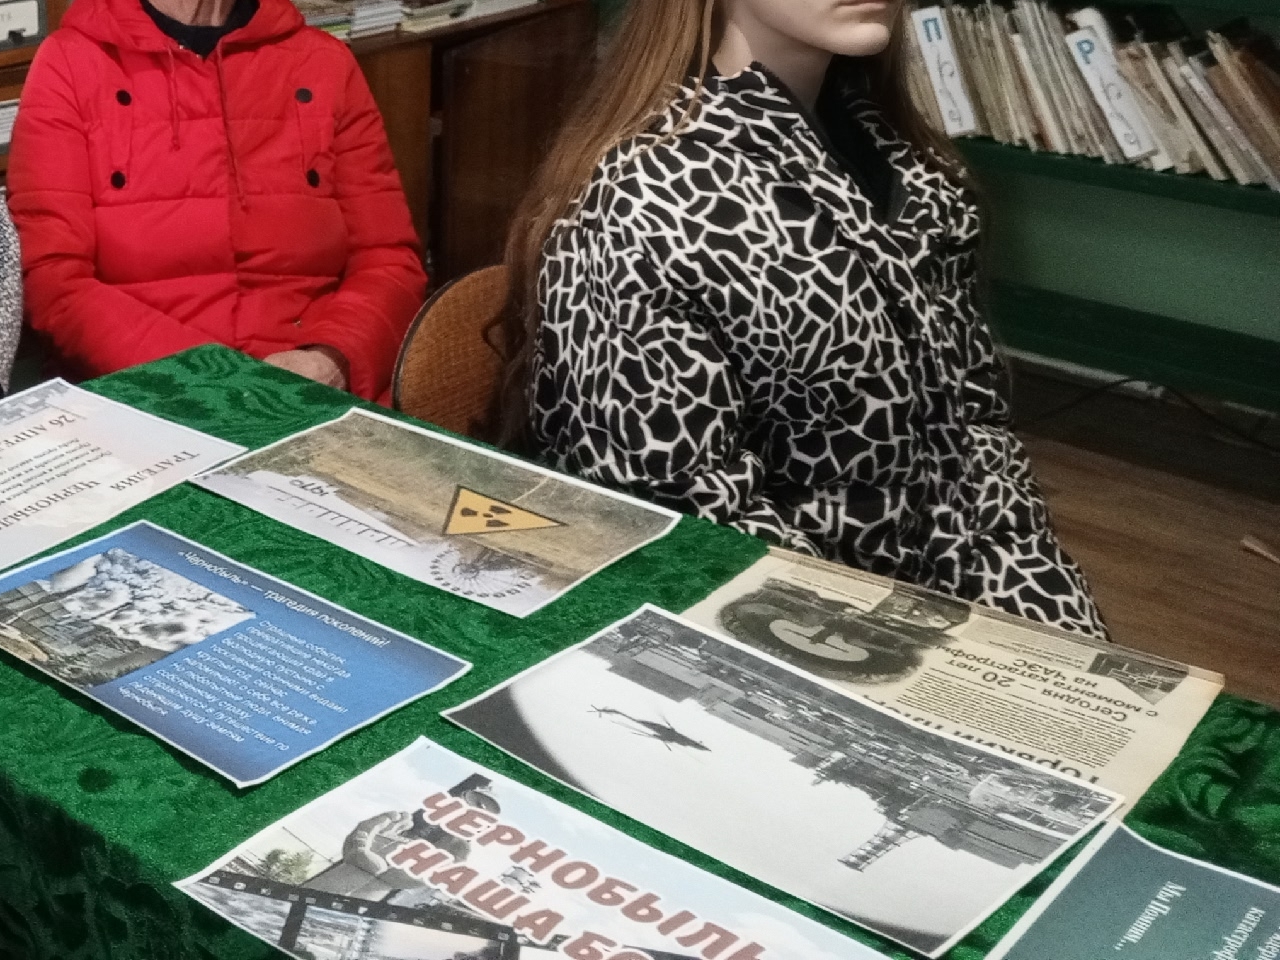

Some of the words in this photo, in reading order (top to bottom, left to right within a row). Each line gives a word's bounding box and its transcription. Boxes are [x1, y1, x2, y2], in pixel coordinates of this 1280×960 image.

[922, 17, 943, 43] П
[1076, 39, 1095, 65] Р
[47, 414, 76, 427] 26
[173, 550, 253, 585] «Чернобыль»
[261, 589, 321, 616] трагедия
[315, 612, 391, 647] поколений!
[934, 644, 1052, 684] катастрофы
[945, 658, 982, 673] лет
[1012, 658, 1070, 681] ЧАЭС
[982, 671, 1016, 689] 20
[1073, 677, 1099, 689] на
[1041, 688, 1128, 722] Сегодня
[1056, 683, 1142, 713] момента
[389, 842, 566, 942] НАША
